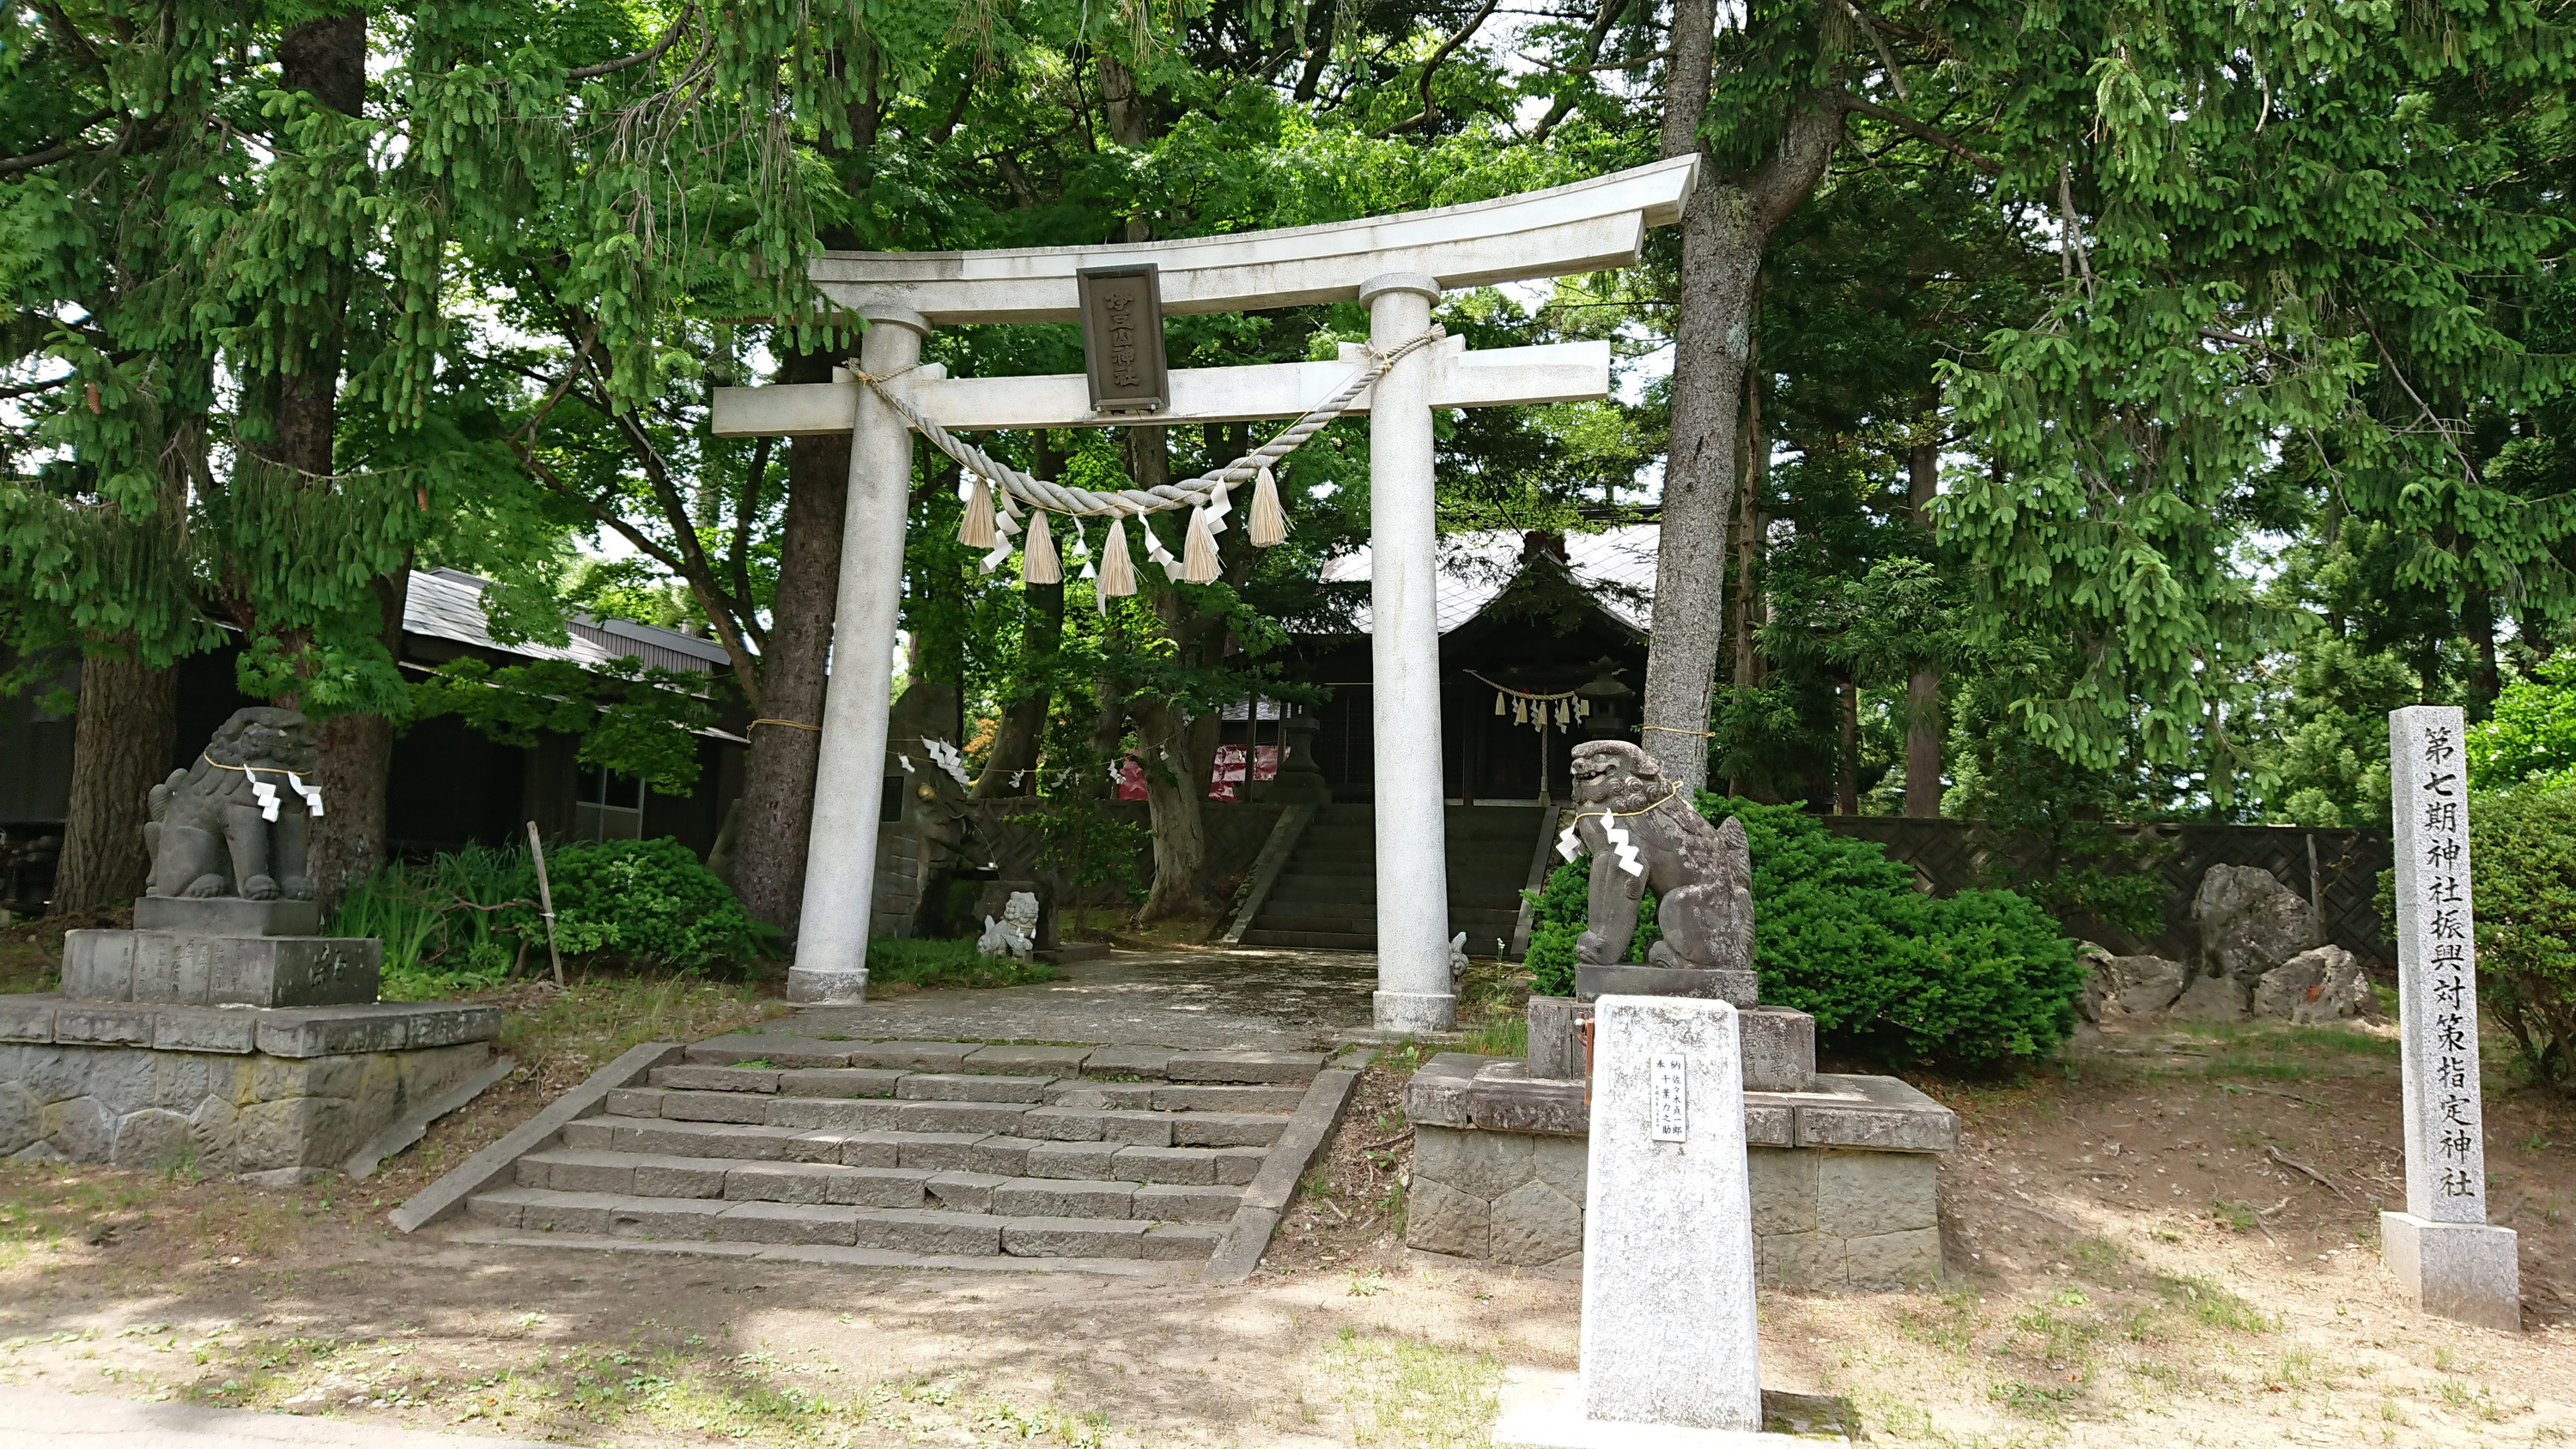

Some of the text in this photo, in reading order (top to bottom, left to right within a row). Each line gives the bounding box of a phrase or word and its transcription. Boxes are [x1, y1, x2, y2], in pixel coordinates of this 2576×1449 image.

[2422, 726, 2475, 1198] 第七期神社振興対策指定神社
[1662, 1074, 1671, 1135] 千葉力之助
